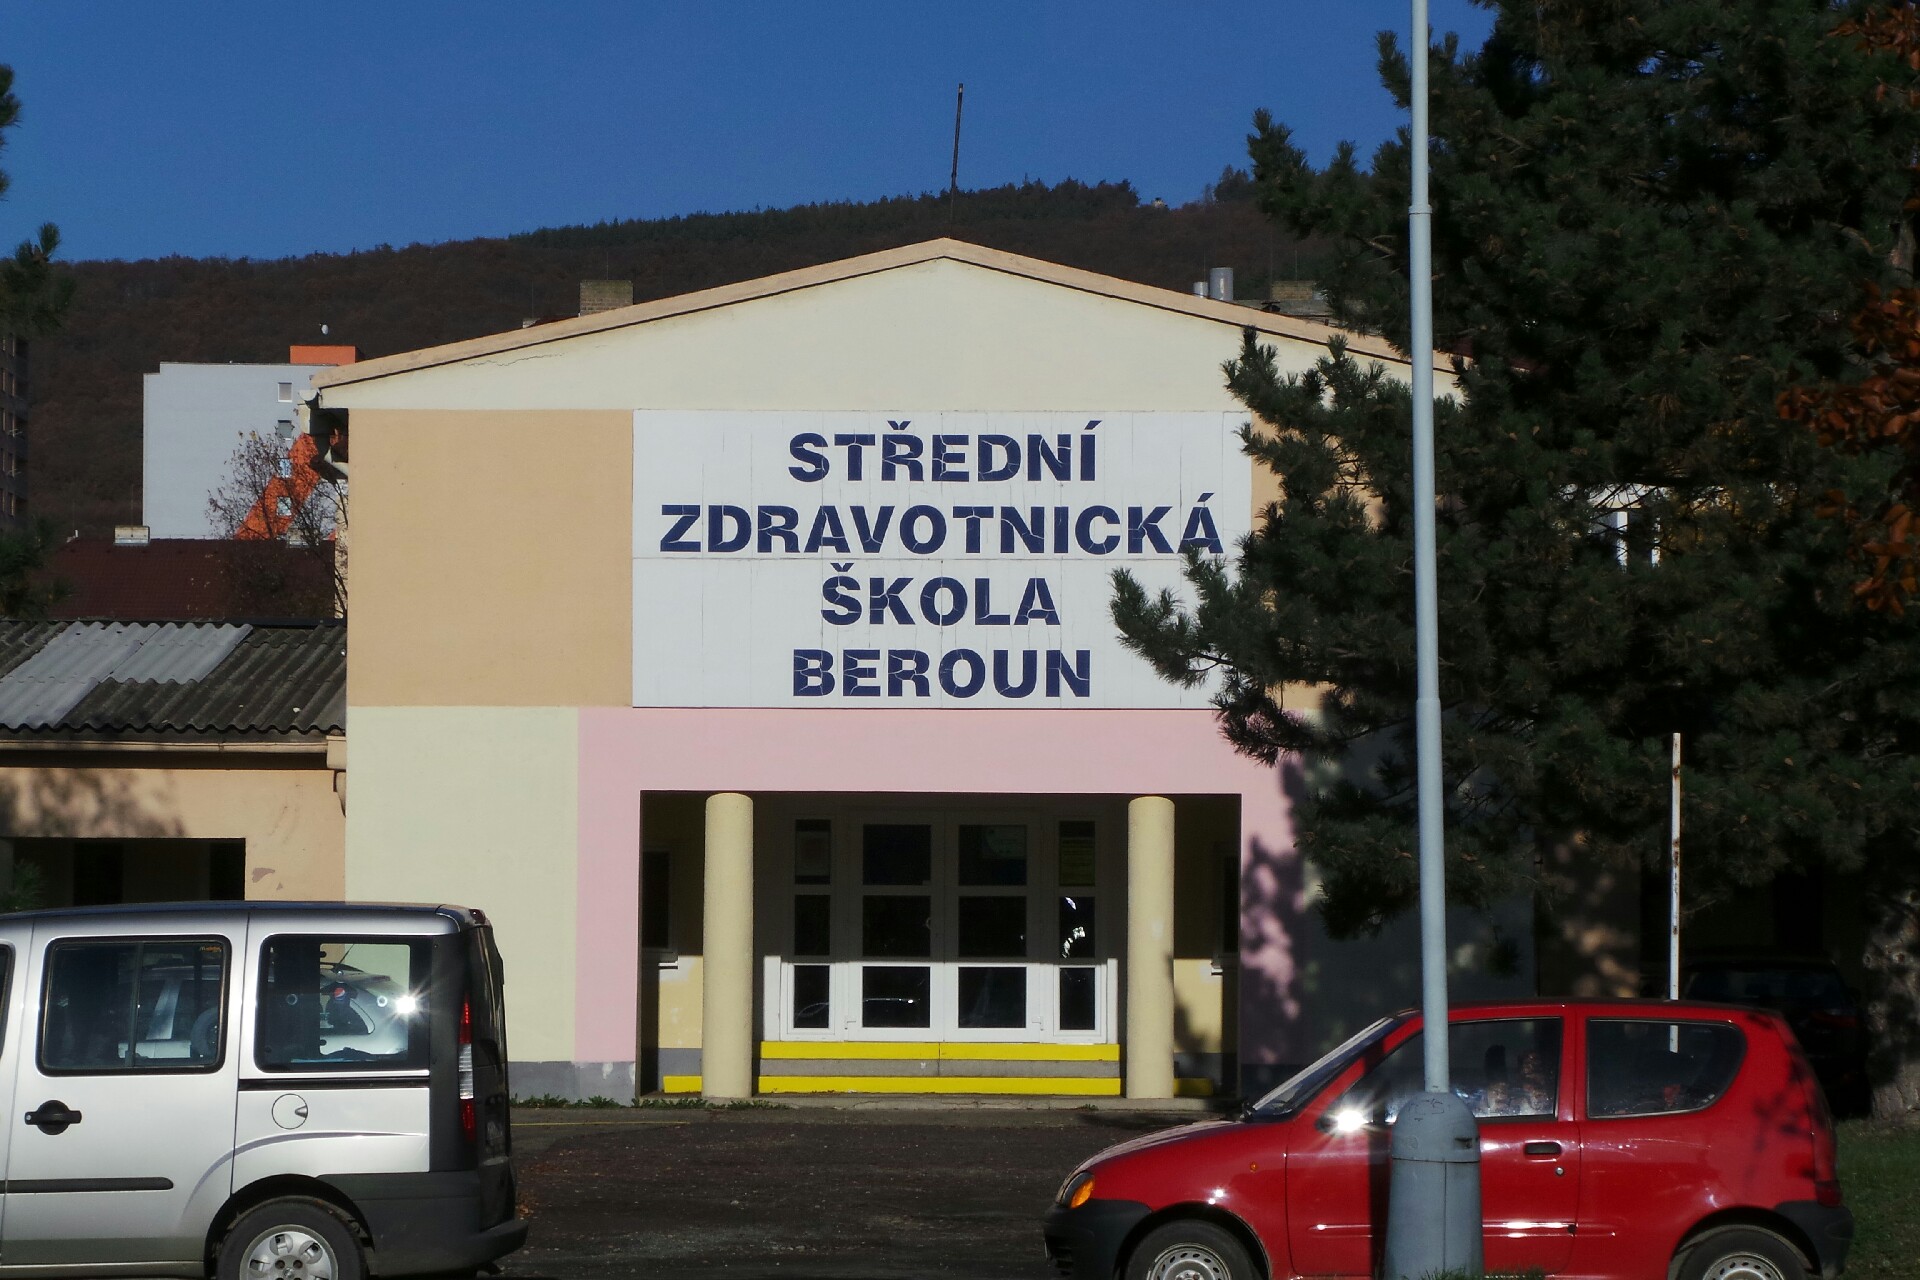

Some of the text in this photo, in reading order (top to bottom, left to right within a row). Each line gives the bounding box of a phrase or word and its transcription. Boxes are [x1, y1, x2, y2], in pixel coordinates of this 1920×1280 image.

[788, 420, 1102, 483] STŘEDNÍ
[660, 492, 1224, 555] ZDRAVOTNICKÁ
[821, 562, 1061, 627] ŠKOLA
[793, 649, 1091, 698] BEROUN
